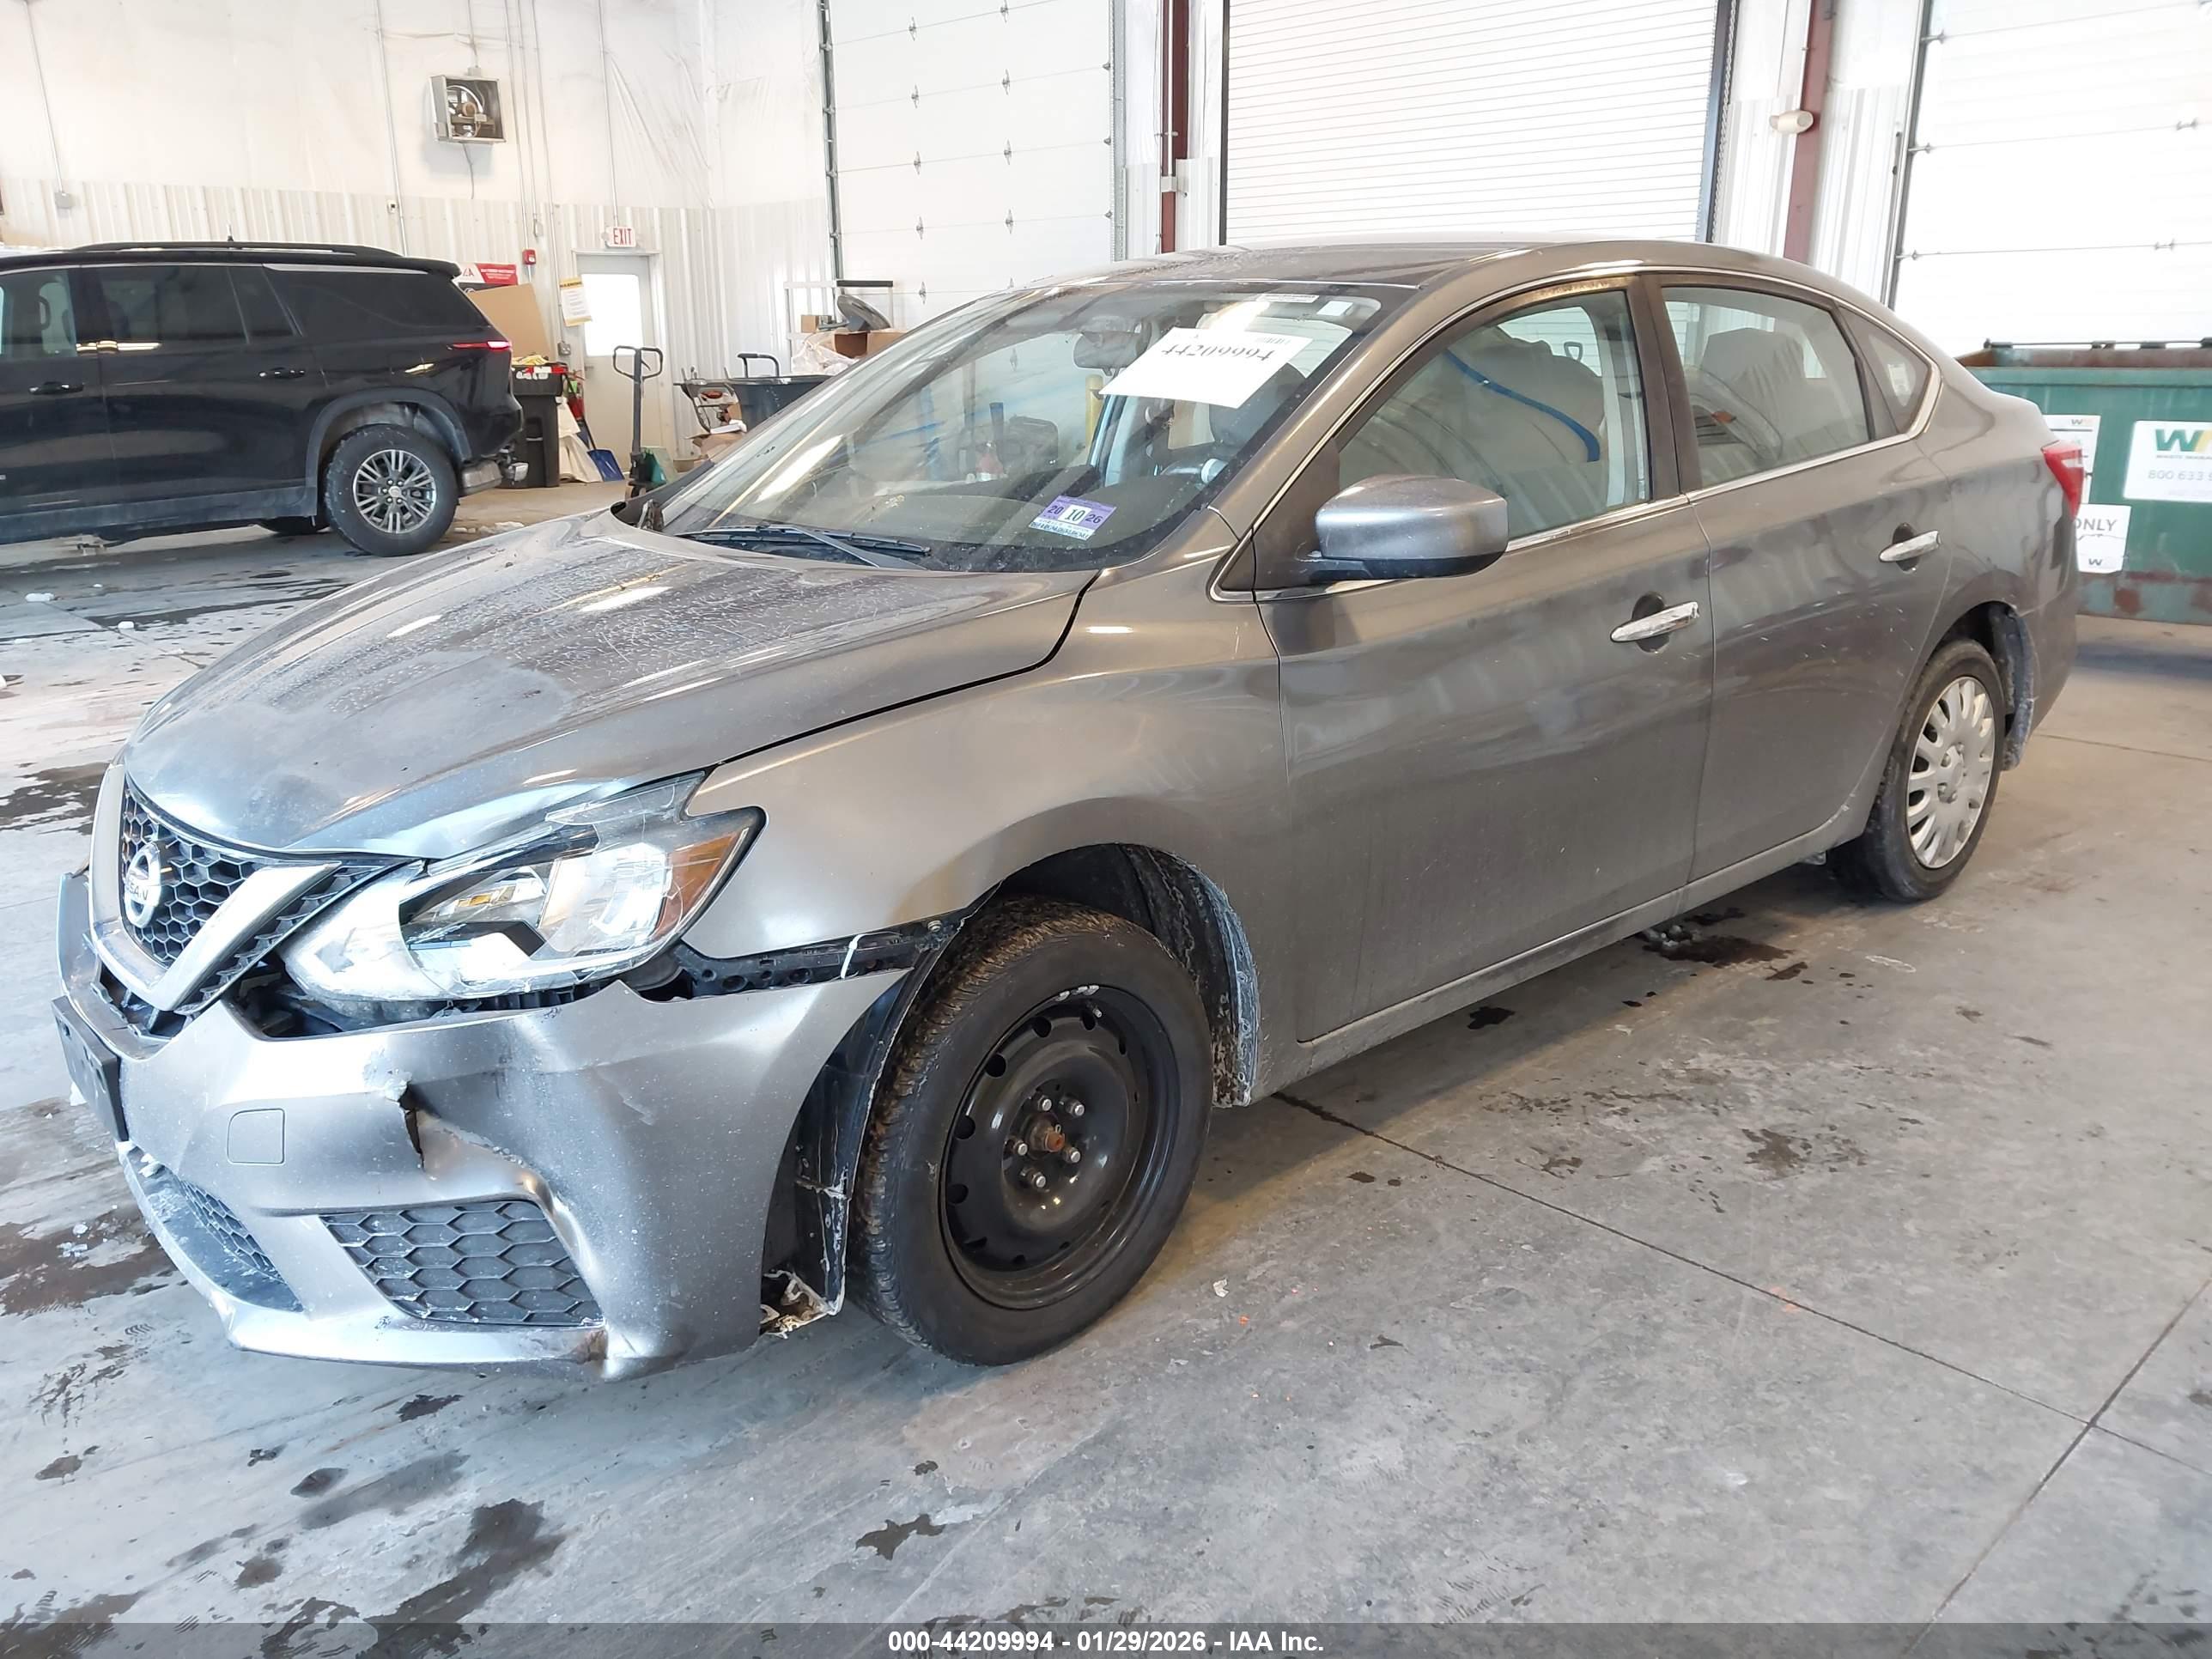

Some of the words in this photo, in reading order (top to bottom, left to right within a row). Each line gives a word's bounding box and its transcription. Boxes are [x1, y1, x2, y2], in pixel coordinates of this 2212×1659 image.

[613, 228, 632, 246] EXIT
[2148, 470, 2174, 480] 800
[1048, 505, 1064, 515] 20
[1065, 508, 1086, 522] 10
[1085, 514, 1103, 524] 26
